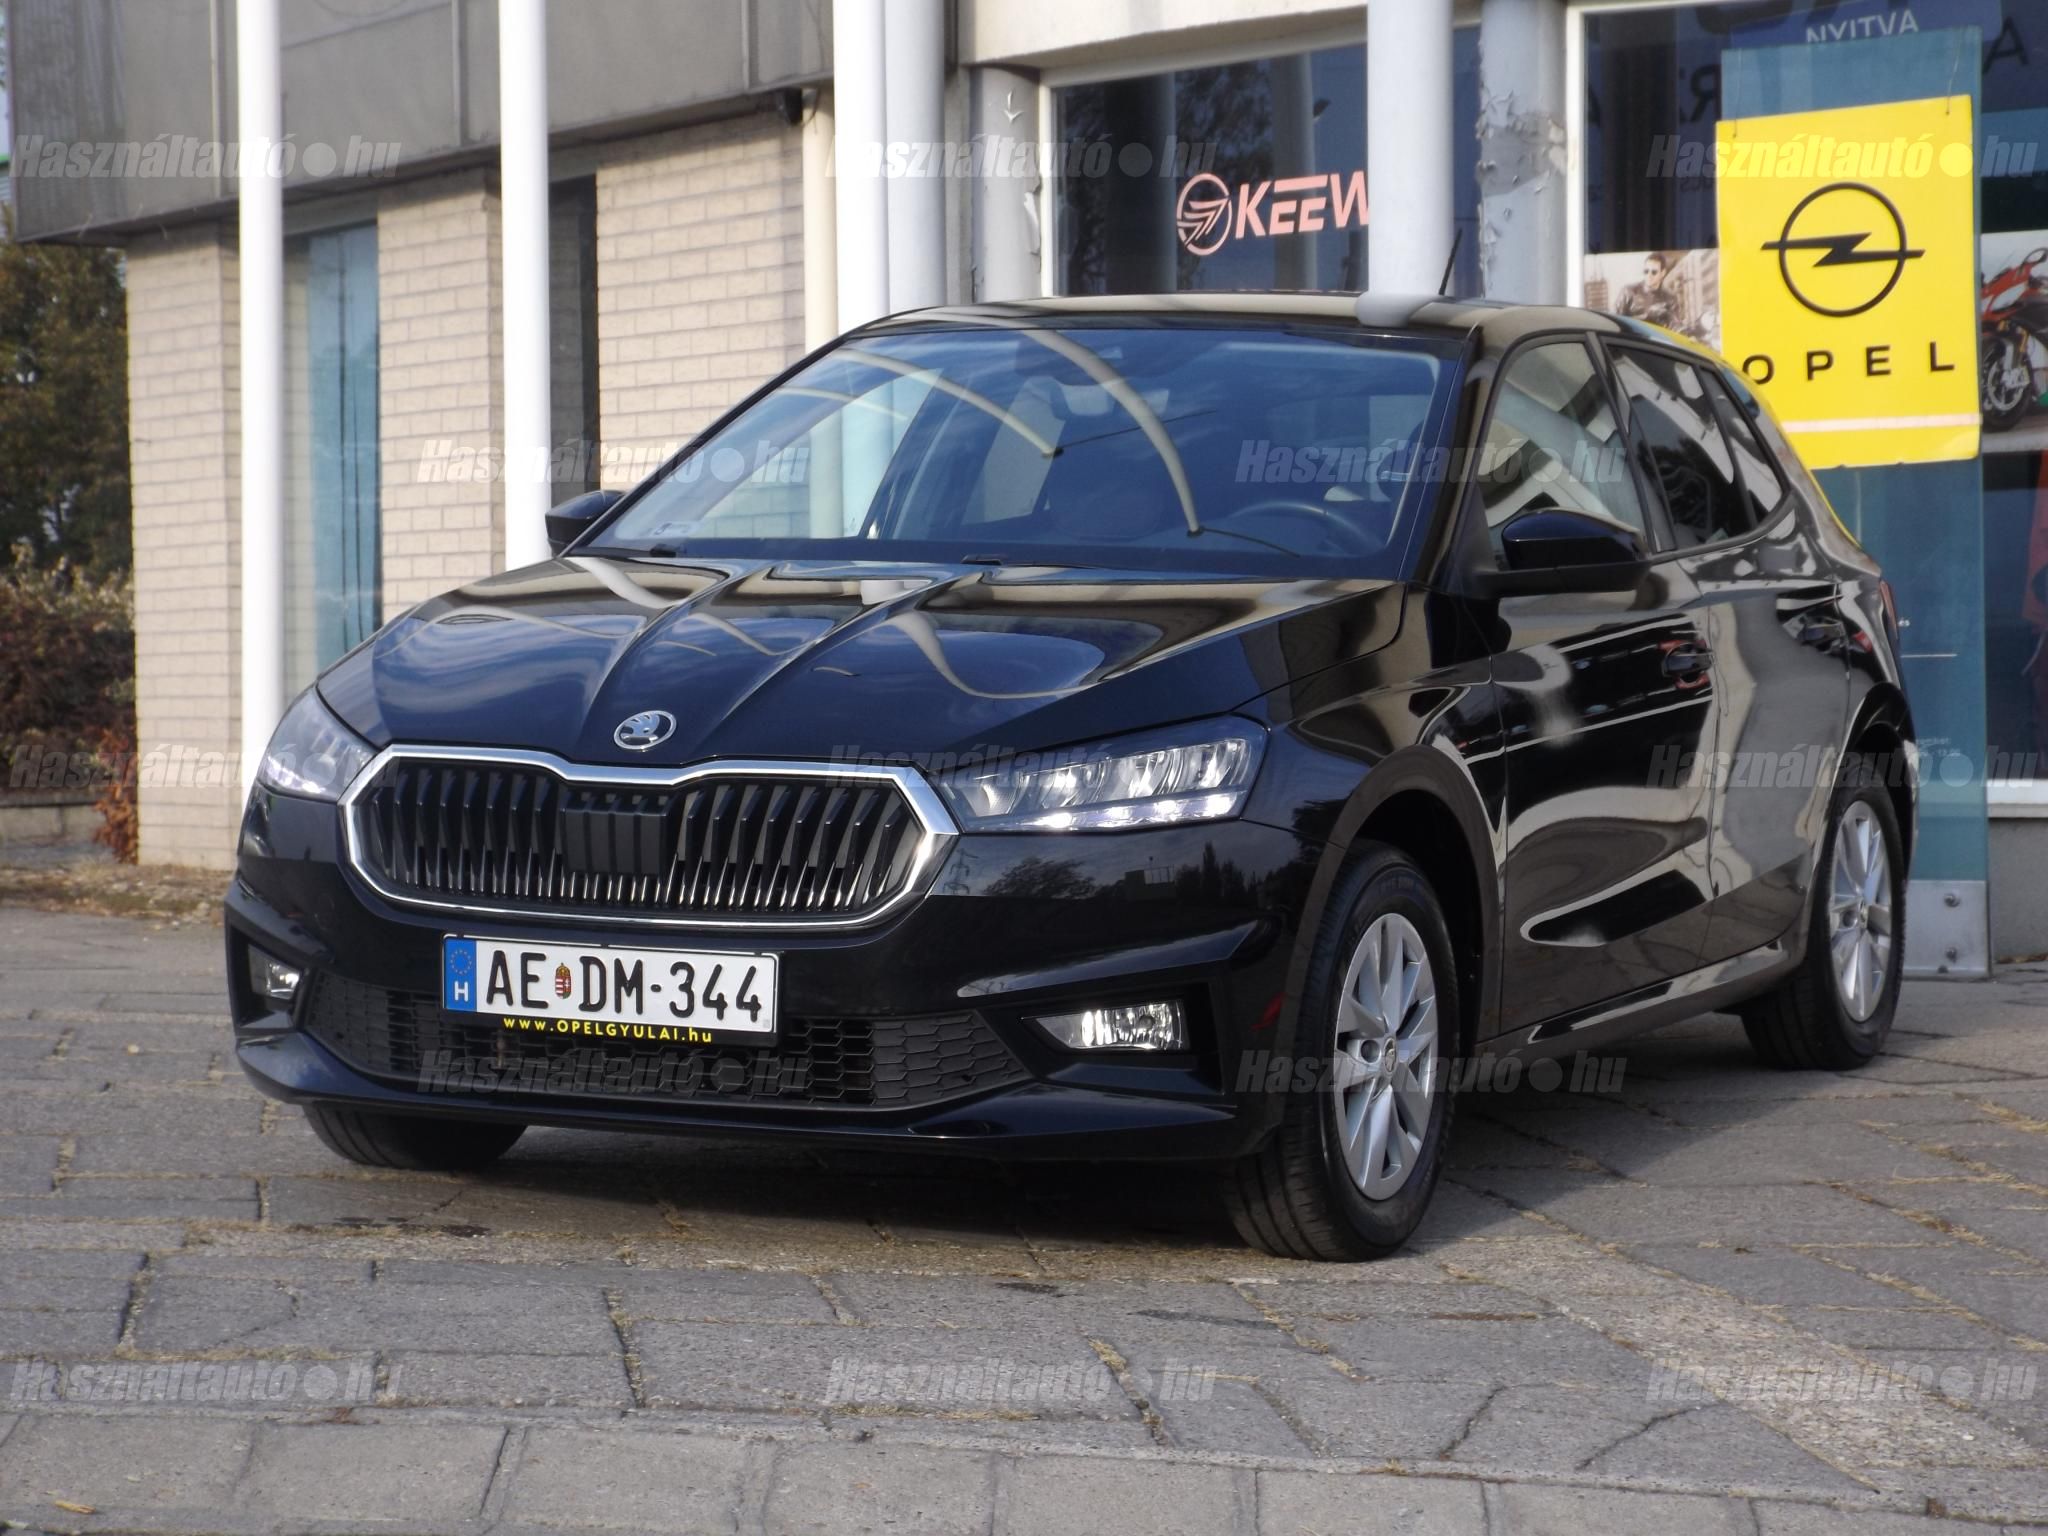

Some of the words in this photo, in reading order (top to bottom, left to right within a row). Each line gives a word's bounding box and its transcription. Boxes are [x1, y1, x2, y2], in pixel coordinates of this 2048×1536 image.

[1806, 9, 1919, 42] NYITVA
[1235, 170, 1369, 239] KEEW
[1742, 341, 1955, 385] OPEL
[453, 980, 469, 1002] H
[578, 954, 763, 1023] DM-344
[502, 1016, 713, 1043] www.OPELGYULAI.hu
